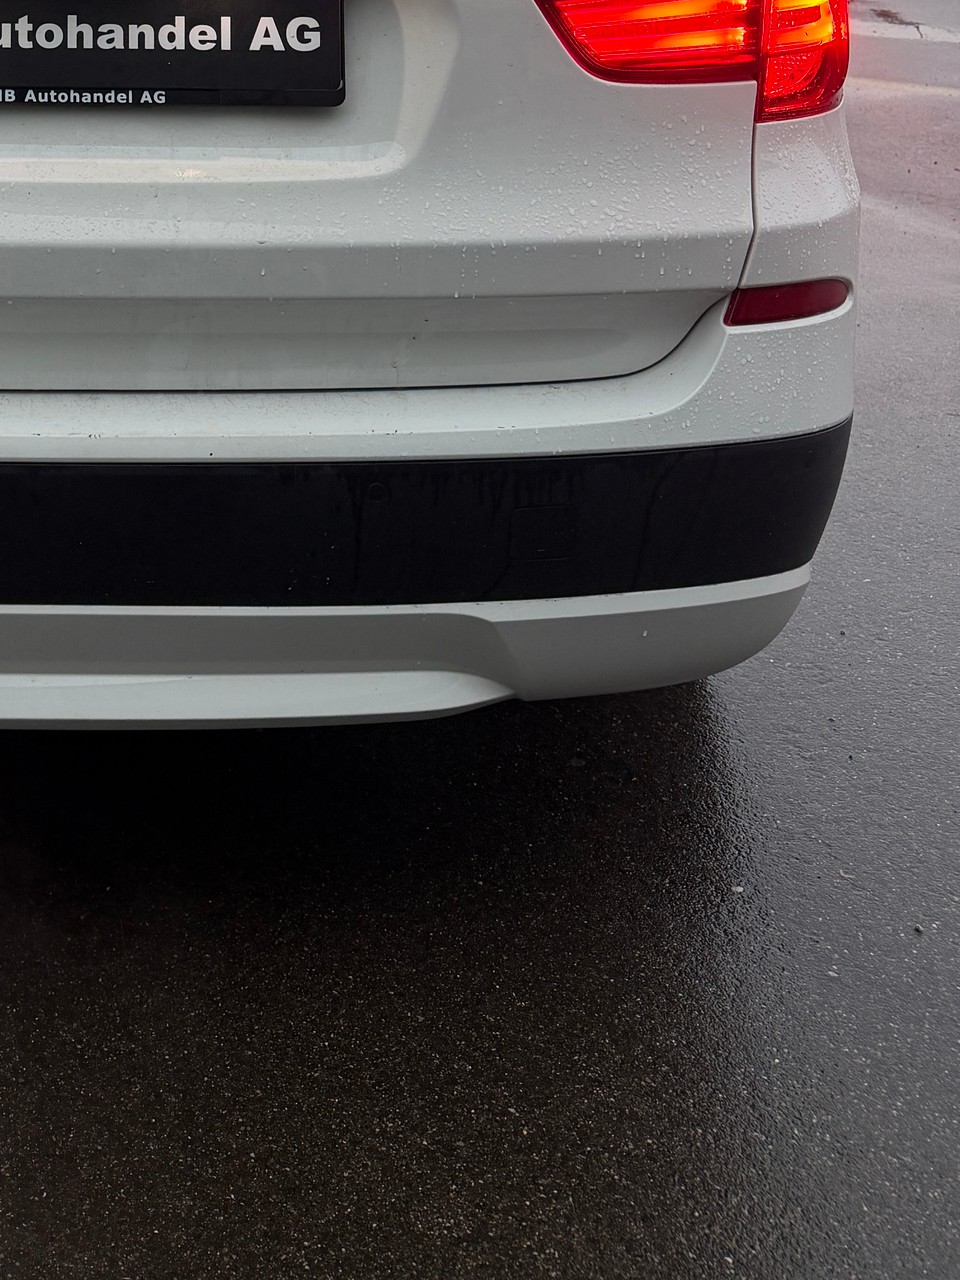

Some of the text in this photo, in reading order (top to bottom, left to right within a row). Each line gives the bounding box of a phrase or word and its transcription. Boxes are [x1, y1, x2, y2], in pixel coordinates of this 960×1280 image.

[248, 16, 322, 52] AG
[24, 89, 134, 104] Autohandel
[139, 90, 167, 105] AG
